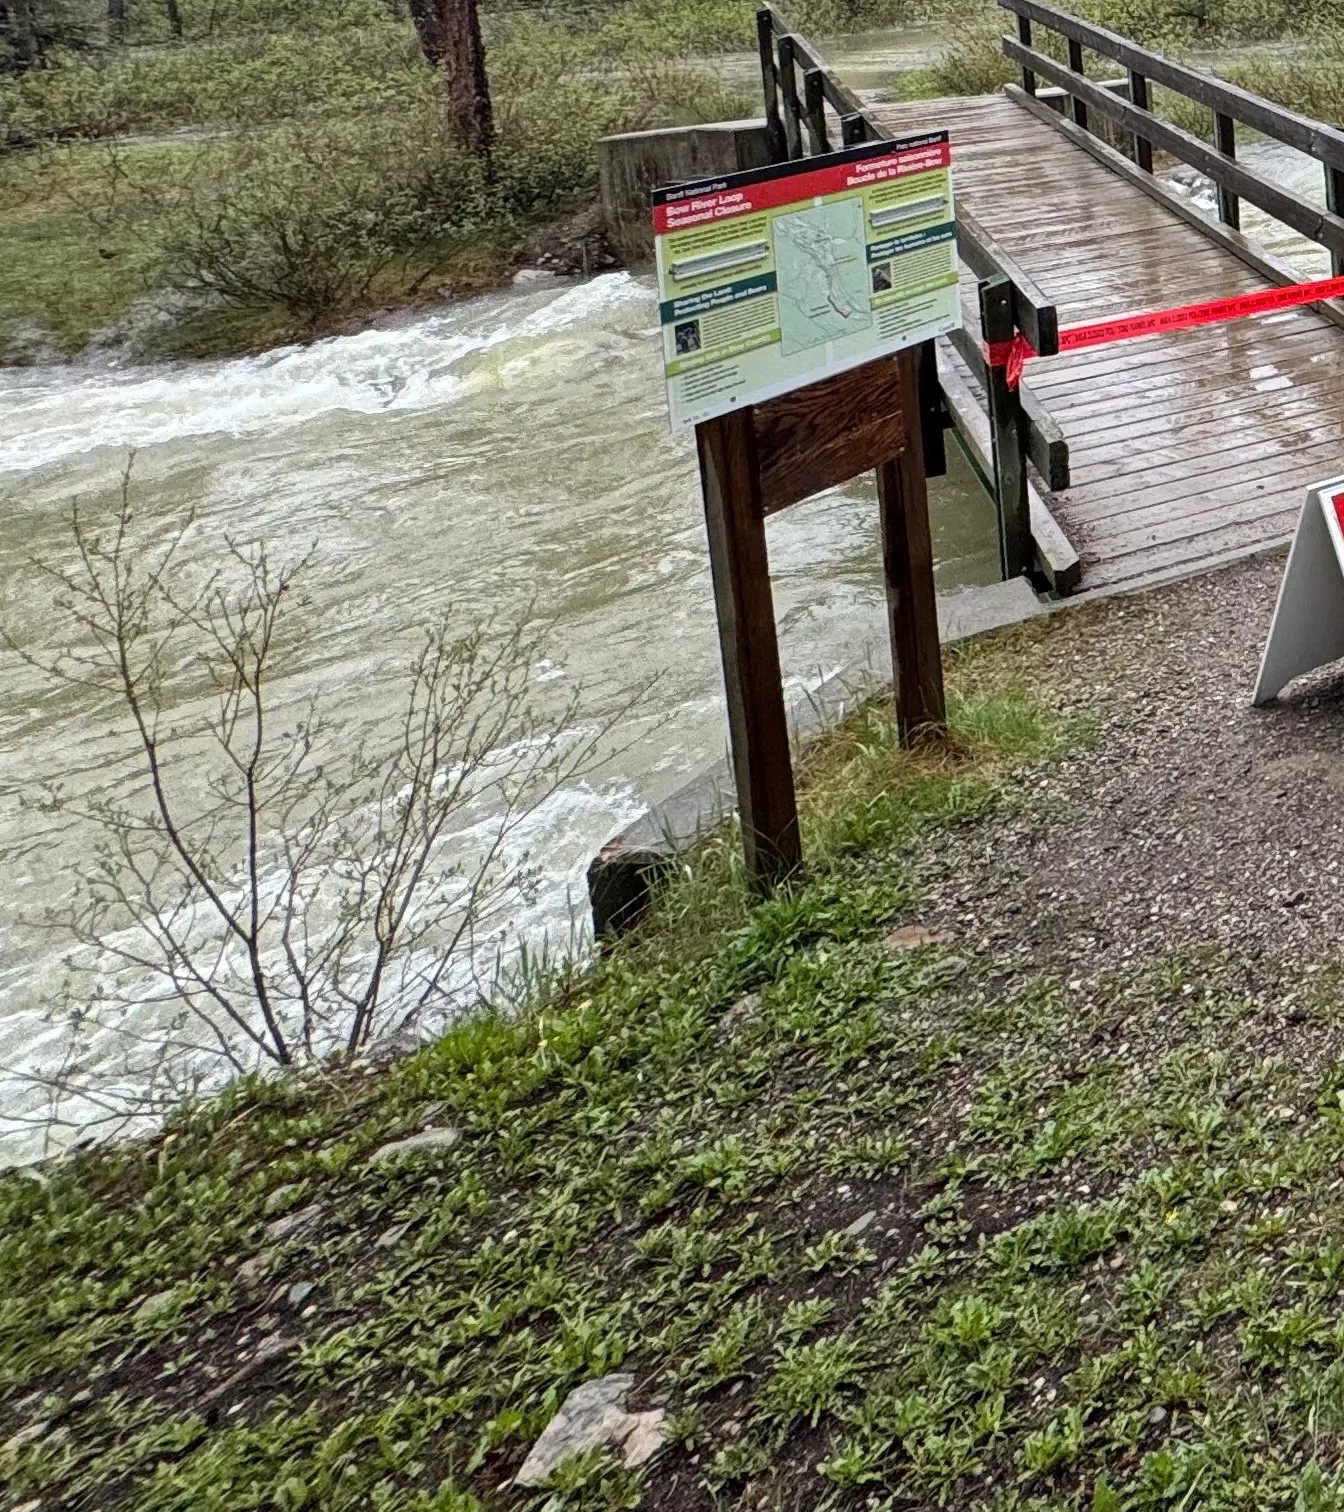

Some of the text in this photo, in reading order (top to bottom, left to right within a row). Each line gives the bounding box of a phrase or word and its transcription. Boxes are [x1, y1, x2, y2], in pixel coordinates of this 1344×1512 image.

[856, 159, 898, 173] Fermeture
[888, 168, 896, 176] la
[666, 182, 727, 200] Banff National Park
[666, 193, 743, 217] Bow River Loop
[667, 202, 752, 228] Seasonal Closure
[674, 296, 700, 308] Sharing
[711, 295, 734, 306] People
[735, 291, 747, 299] and
